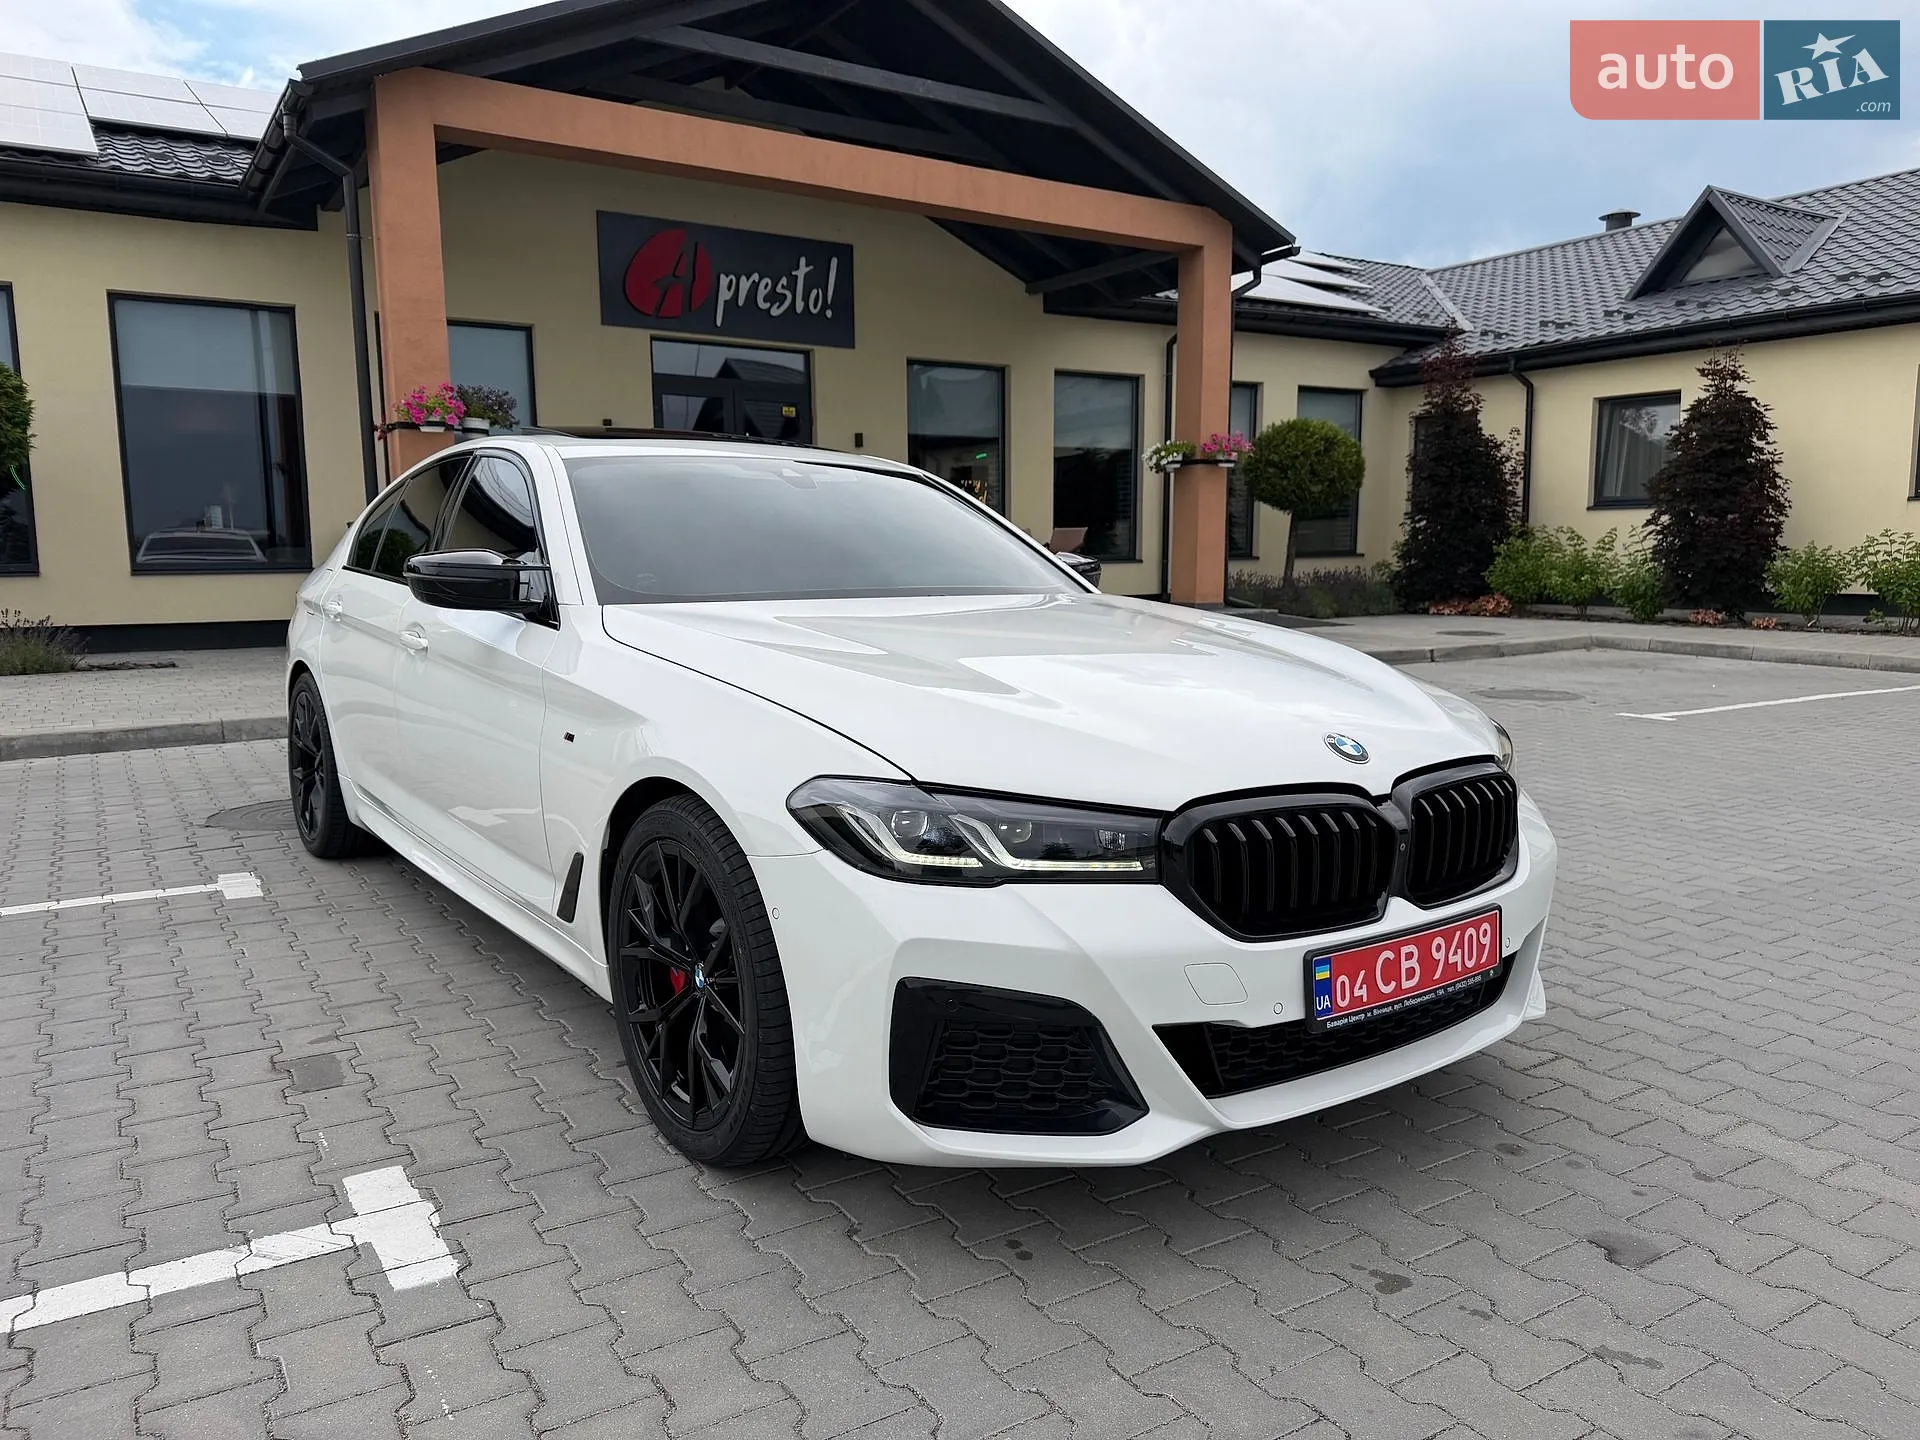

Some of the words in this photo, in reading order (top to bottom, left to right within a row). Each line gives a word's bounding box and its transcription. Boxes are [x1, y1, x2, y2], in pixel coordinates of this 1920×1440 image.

[715, 256, 838, 327] presto!
[1335, 970, 1368, 1009] 04
[1375, 944, 1421, 994] CB
[1431, 922, 1491, 981] 9409
[1316, 994, 1331, 1011] UA
